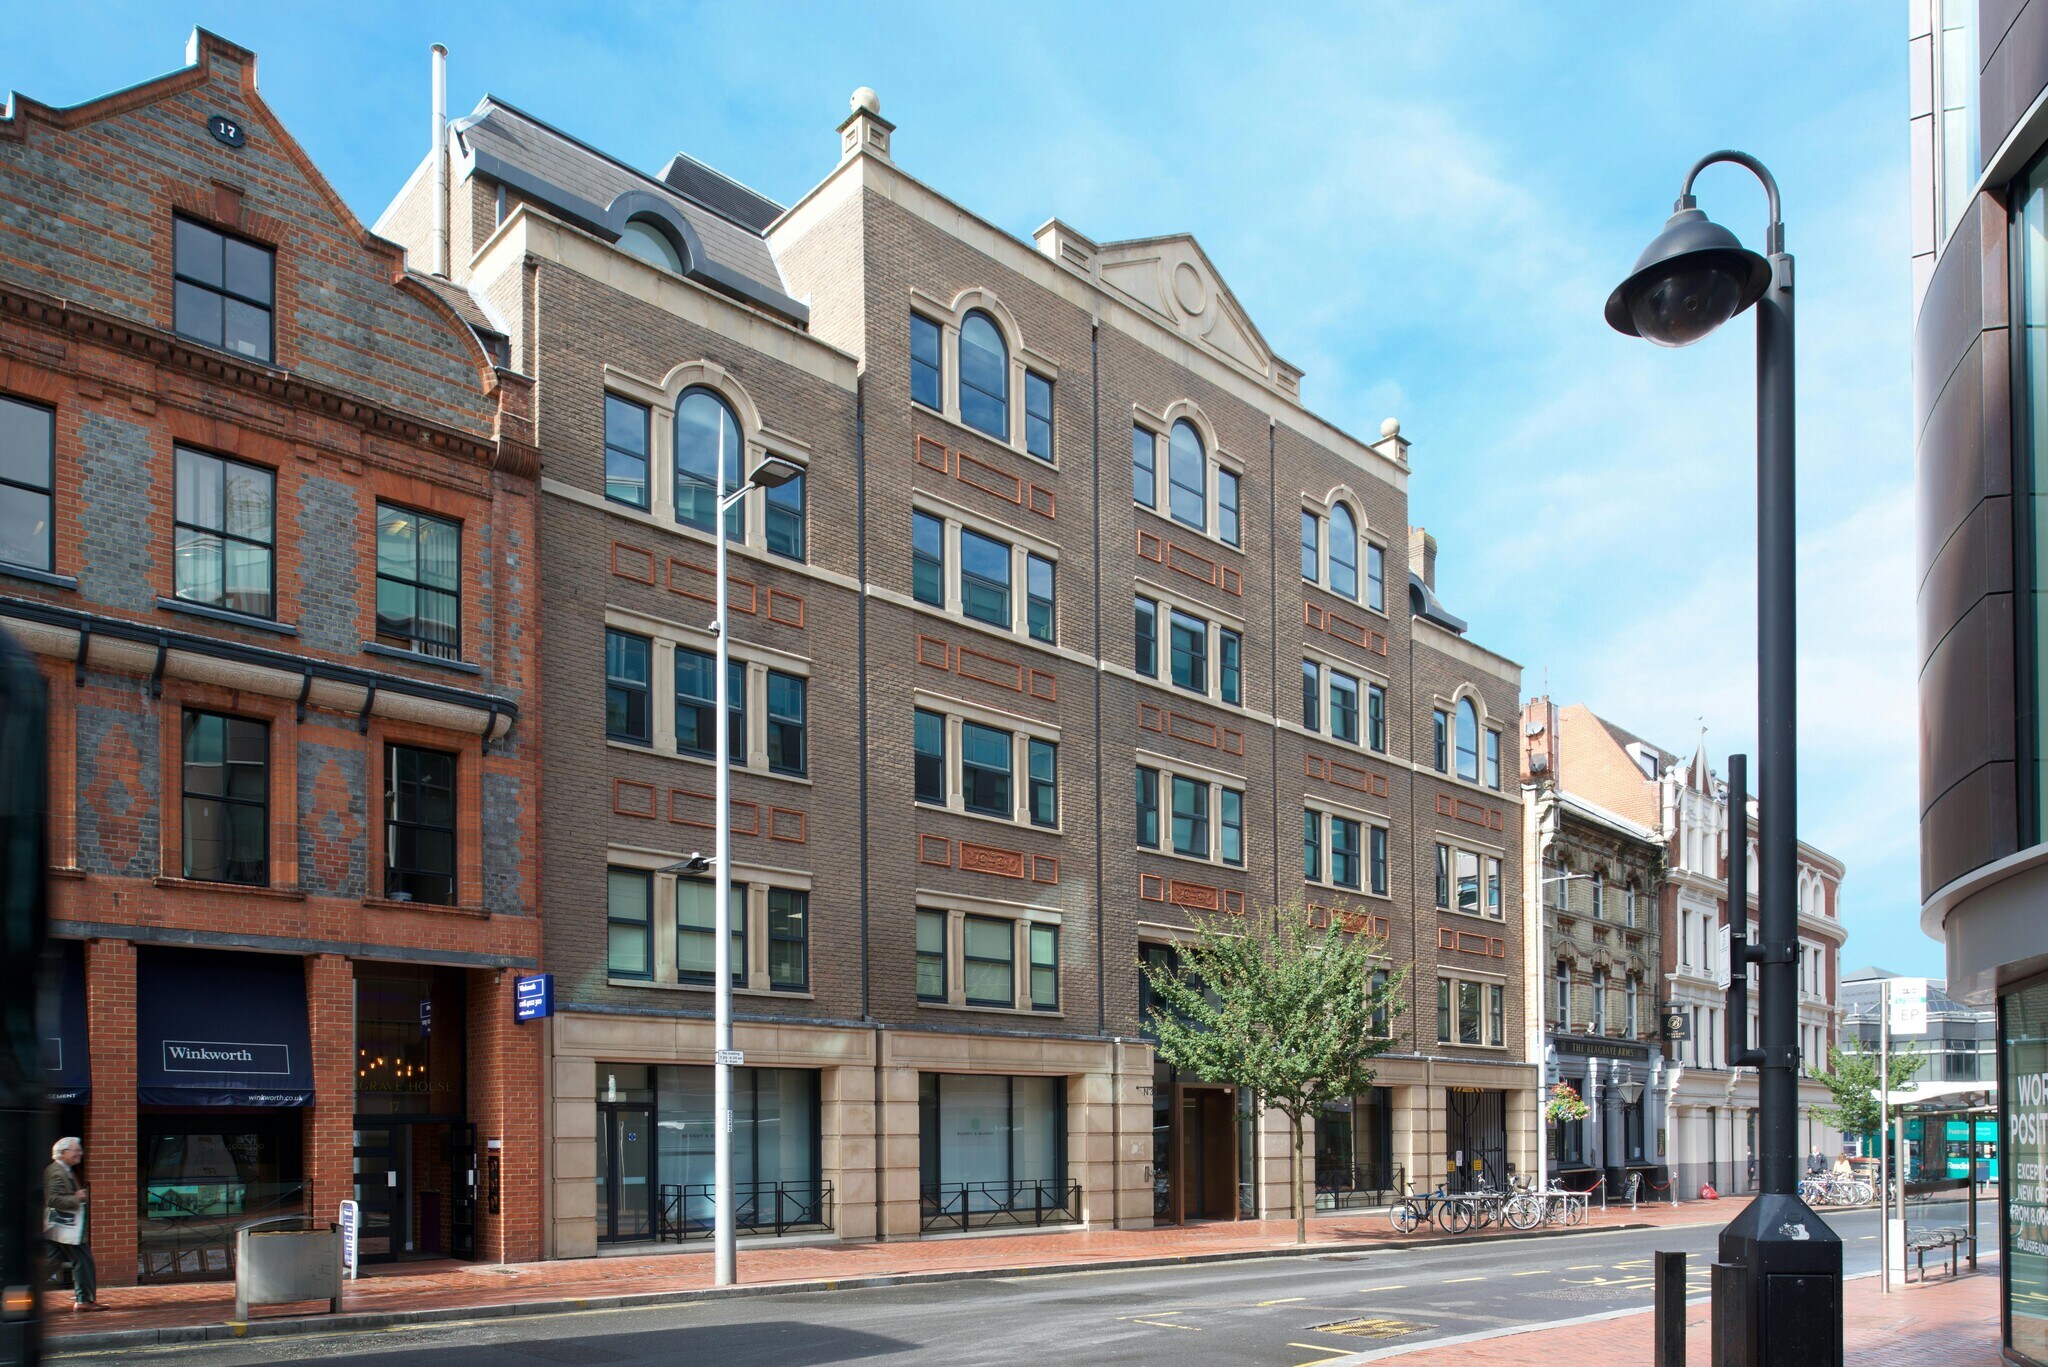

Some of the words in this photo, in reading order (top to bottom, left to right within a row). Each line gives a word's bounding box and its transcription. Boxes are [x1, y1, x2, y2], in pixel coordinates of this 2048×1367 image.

[220, 122, 236, 138] 17
[168, 1046, 252, 1061] Winkworth
[1572, 1043, 1584, 1052] THE
[1586, 1044, 1617, 1055] BLAGRAVE
[1619, 1047, 1634, 1057] ARMS
[409, 1081, 453, 1091] HOUSE
[248, 1094, 303, 1102] winkworth.co.uk
[2017, 1184, 2034, 1202] NEW
[2011, 1204, 2029, 1222] FROM
